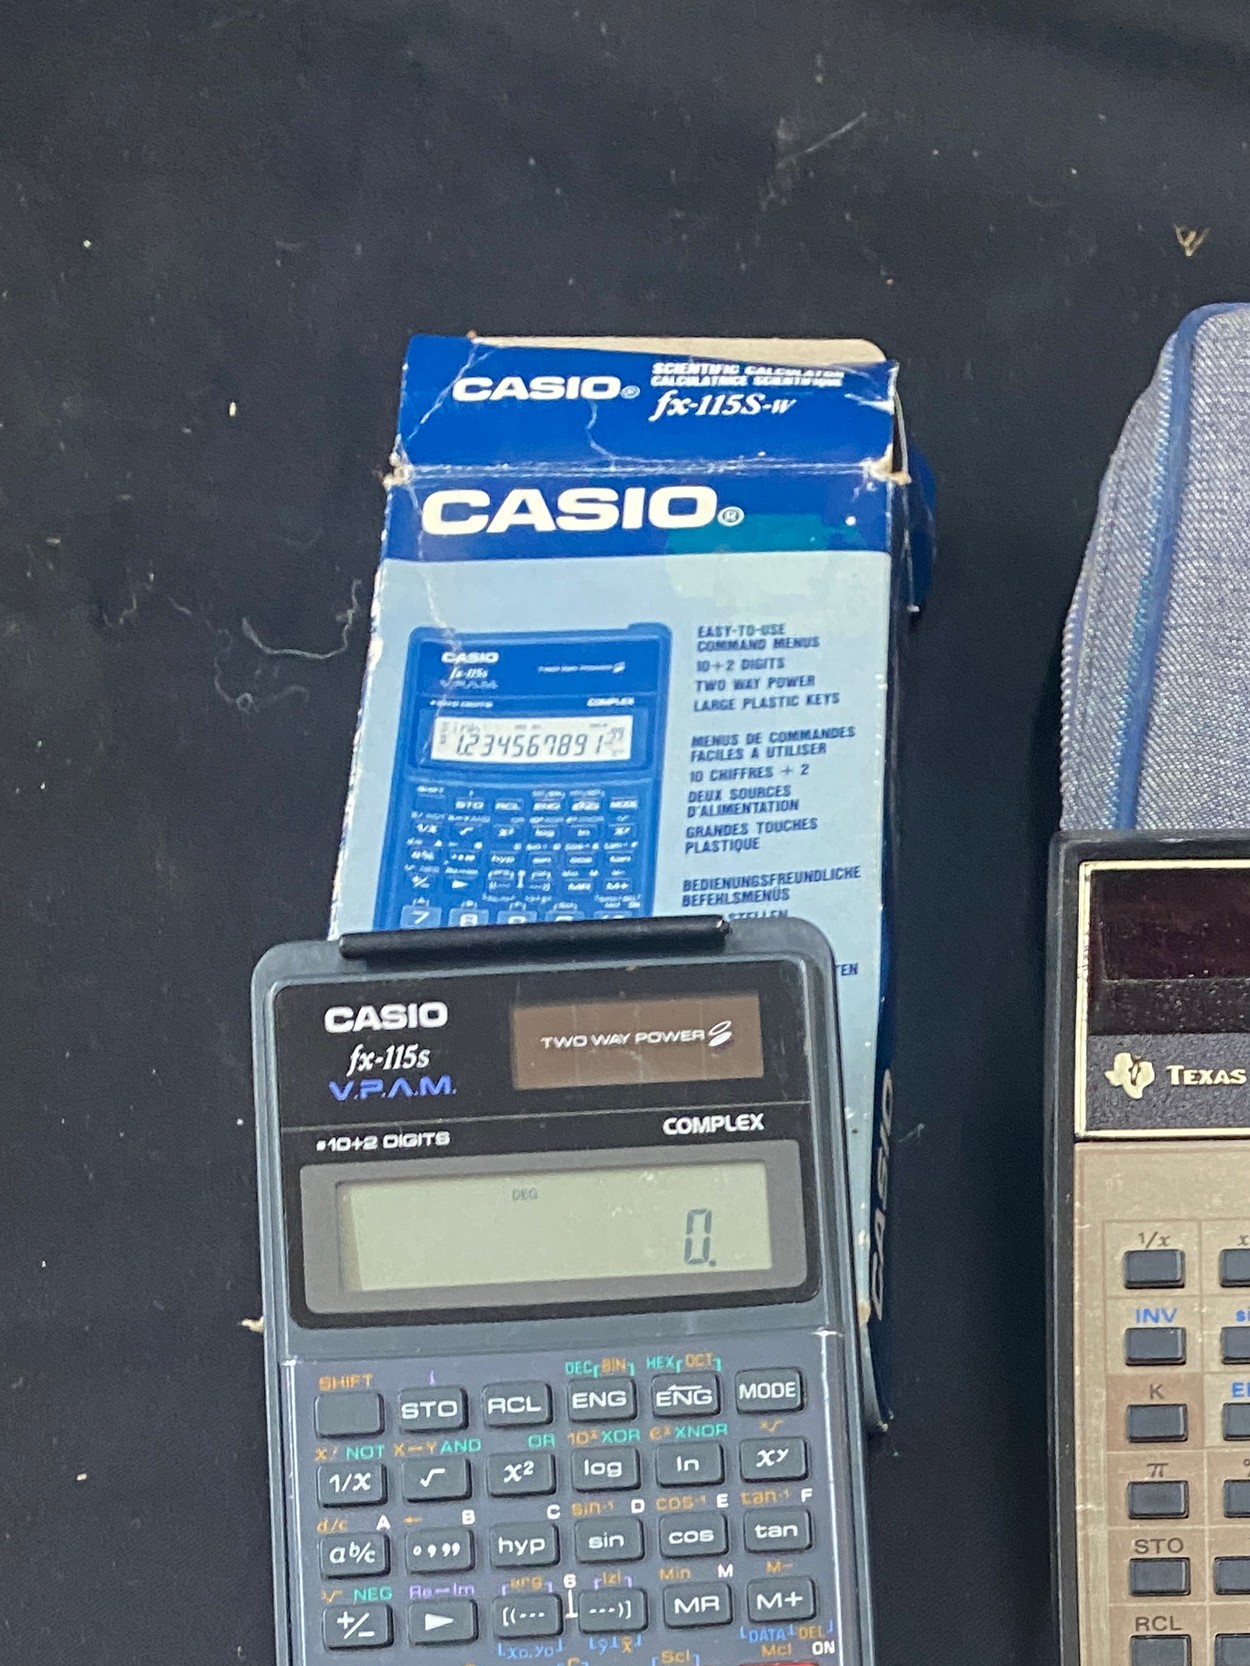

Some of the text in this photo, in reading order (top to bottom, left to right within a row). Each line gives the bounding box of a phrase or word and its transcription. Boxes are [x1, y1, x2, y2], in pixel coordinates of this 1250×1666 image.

[652, 362, 739, 375] SCIENTIFIC
[452, 376, 620, 402] CASIO
[422, 486, 718, 535] CASIO
[698, 623, 786, 639] EASY-TO-USE
[697, 636, 819, 652] COMMAND MENUS
[696, 657, 785, 672] 10+2 DIGITS
[695, 675, 815, 692] TWO WAY POWER
[694, 692, 840, 712] LARGE PLASTIC KEYS
[691, 726, 856, 748] MENUS DE COMMANDES
[691, 748, 744, 762] FACILES
[767, 742, 826, 758] UTILISER
[690, 764, 809, 782] 10 CHIFFRES 2
[688, 785, 791, 803] DEUX SOURCES
[687, 799, 799, 818] D'ALIMENTATION
[686, 818, 818, 839] GRANDES TOUCHES
[685, 837, 760, 854] PLASTIQUE
[683, 865, 861, 892] BEDIENUNGSFREUNDLICHE
[682, 887, 790, 907] BEFEHLSMENÜS
[324, 1001, 448, 1033] CASIO
[540, 1029, 705, 1050] TWO WAY POWER
[346, 1044, 430, 1075] fx-115s
[1166, 1064, 1247, 1086] TEXAS
[663, 1113, 765, 1135] COMPLEX
[383, 1131, 450, 1148] DIGITS
[871, 1068, 893, 1321] CASIO
[1136, 1307, 1177, 1323] INV
[602, 1358, 626, 1372] BIN
[647, 1353, 713, 1369] HEX OCT
[319, 1373, 373, 1390] SHIFT
[739, 1382, 796, 1398] MODE
[572, 1391, 627, 1409] ENG
[656, 1390, 712, 1407] ENG
[1150, 1384, 1164, 1399] K
[402, 1401, 457, 1420] STO
[488, 1396, 541, 1414] RCL
[601, 1429, 640, 1443] XOR
[675, 1423, 728, 1439] XNOR
[440, 1438, 481, 1454] AND
[528, 1434, 555, 1448] OR
[346, 1445, 385, 1460] NOT
[584, 1459, 622, 1477] log
[717, 1494, 729, 1508] E
[801, 1488, 813, 1503] F
[547, 1504, 561, 1520] C
[631, 1499, 644, 1513] D
[376, 1515, 391, 1530] A
[462, 1509, 475, 1525] B
[669, 1529, 714, 1544] cos
[755, 1524, 798, 1539] tan
[499, 1537, 545, 1555] hyp
[589, 1532, 624, 1549] sin
[1134, 1538, 1184, 1554] STO
[660, 1567, 691, 1580] Min
[718, 1564, 733, 1578] M
[354, 1587, 392, 1601] NEG
[757, 1593, 803, 1610] M+
[674, 1595, 720, 1614] MR
[1135, 1615, 1182, 1632] RCL
[749, 1628, 786, 1642] DATA
[798, 1626, 825, 1640] DEL
[812, 1641, 835, 1655] ON
